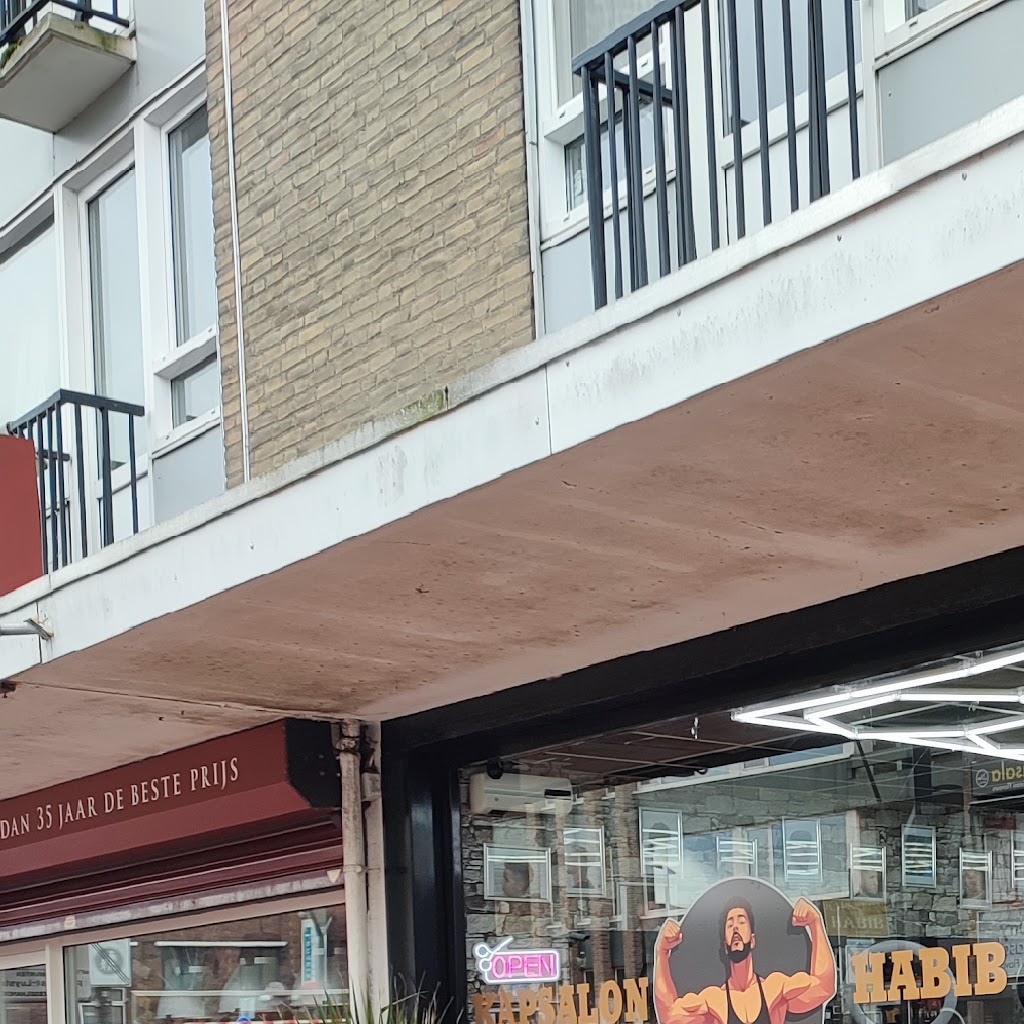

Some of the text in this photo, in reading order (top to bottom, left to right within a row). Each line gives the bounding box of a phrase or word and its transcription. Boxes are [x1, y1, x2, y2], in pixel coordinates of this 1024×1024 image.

[0, 757, 239, 839] DAN 35 JAAR DE BESTE PRIJS
[491, 954, 555, 979] OPEN
[851, 941, 1008, 1004] HABIB
